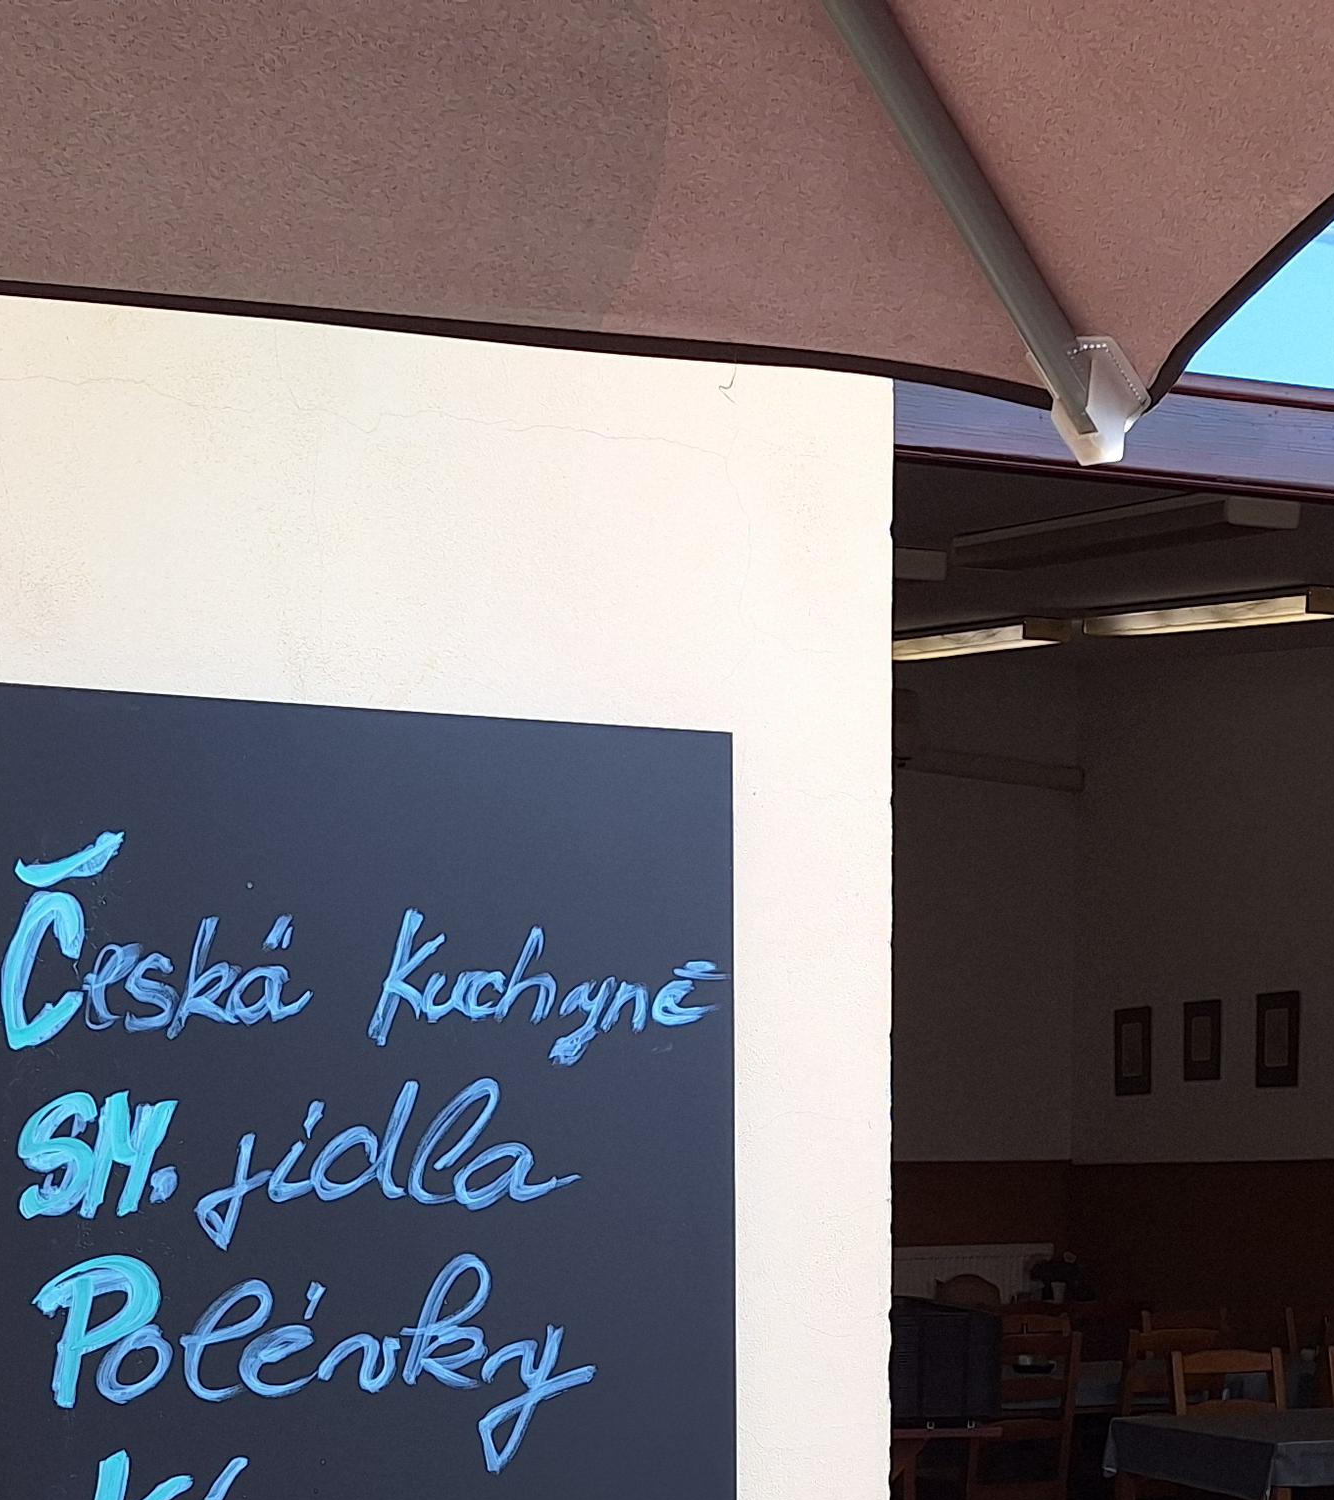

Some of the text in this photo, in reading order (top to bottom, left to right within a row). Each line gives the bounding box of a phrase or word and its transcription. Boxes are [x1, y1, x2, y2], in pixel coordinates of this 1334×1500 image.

[0, 830, 313, 1051] Česká
[17, 1077, 581, 1250] SM. jídla
[31, 1254, 597, 1474] Polévky
